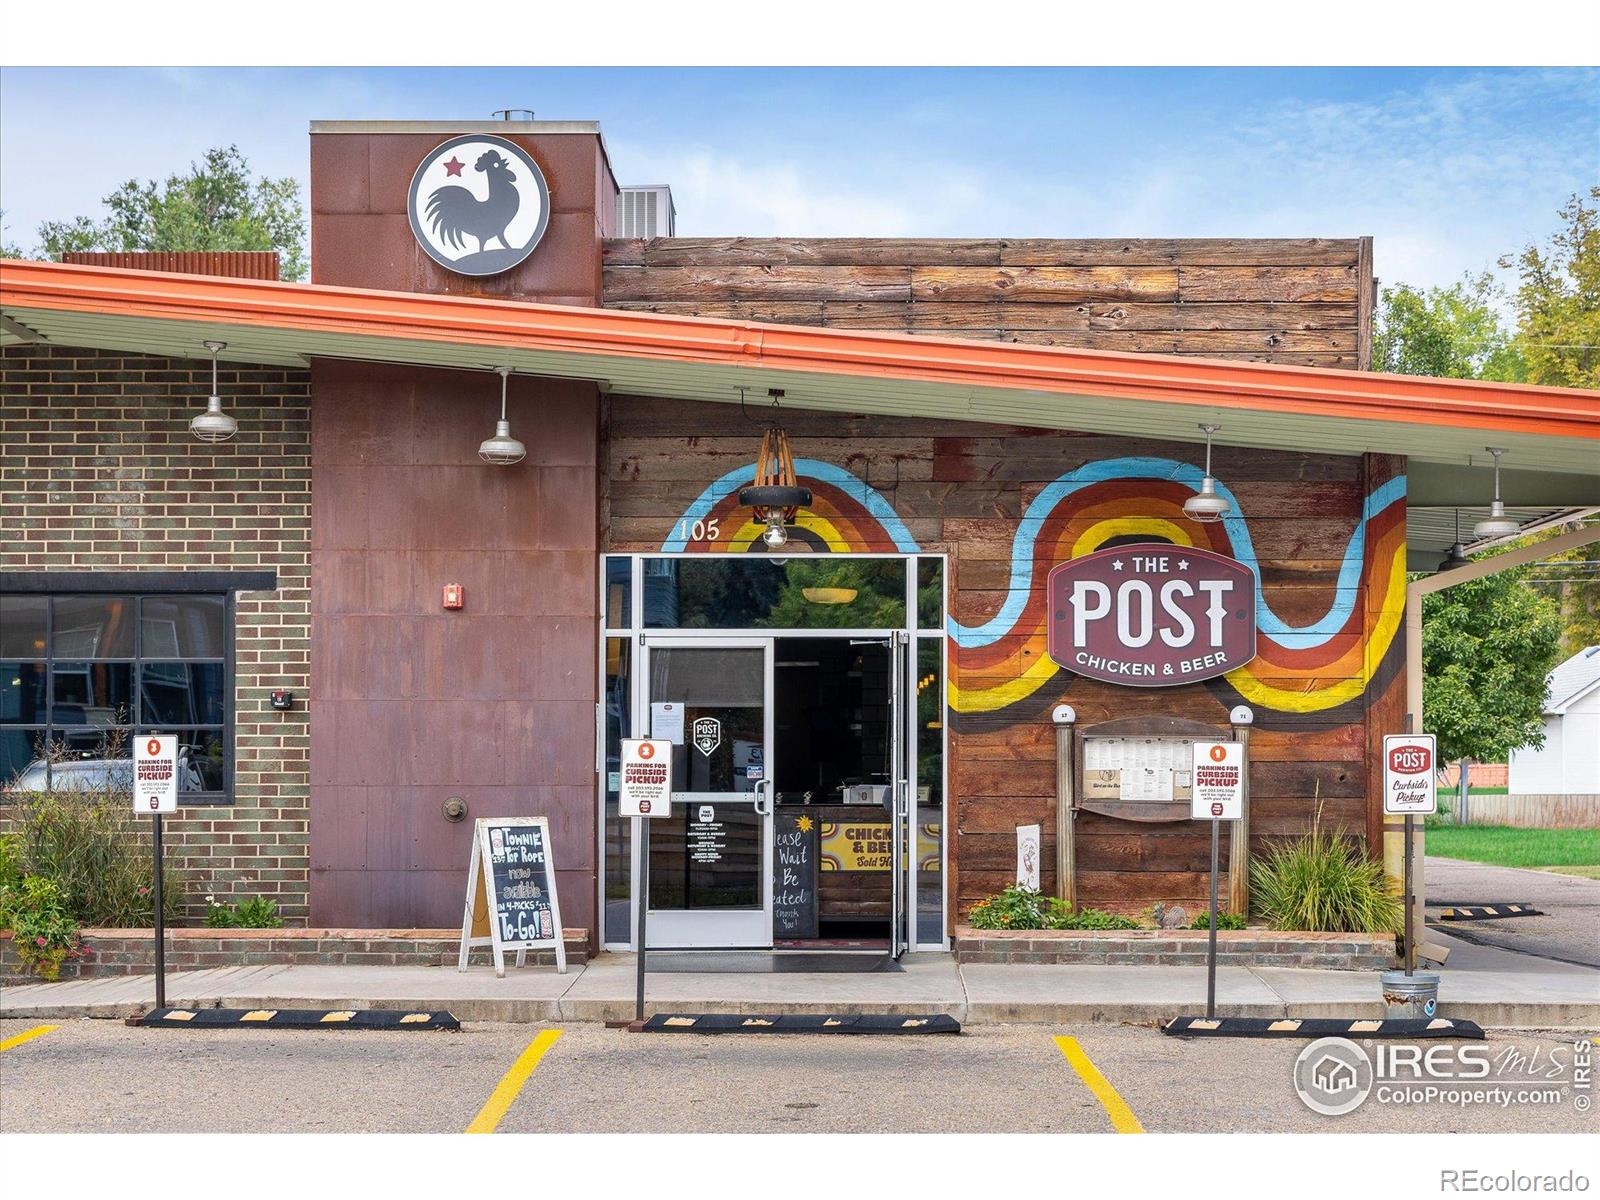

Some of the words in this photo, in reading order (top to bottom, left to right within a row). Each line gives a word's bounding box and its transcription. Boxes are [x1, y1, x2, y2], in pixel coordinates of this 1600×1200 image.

[680, 518, 720, 541] 105
[1132, 556, 1169, 573] THE
[1068, 579, 1234, 648] POST
[1076, 652, 1155, 676] CHICKEN
[1163, 662, 1174, 676] &
[1180, 651, 1228, 674] BEER
[696, 724, 718, 734] POST
[151, 743, 157, 752] 3
[642, 746, 649, 755] 2
[1215, 750, 1220, 758] 1
[1393, 752, 1426, 768] POST
[138, 772, 172, 780] PICKUP
[626, 776, 666, 784] PICKUP
[1197, 779, 1238, 787] PICKUP
[1396, 792, 1426, 804] Pickup
[774, 832, 801, 847] lease
[852, 842, 864, 853] &
[521, 846, 544, 863] ROPE
[779, 846, 807, 865] Wait
[856, 856, 878, 867] Sold
[508, 868, 530, 880] now
[784, 867, 798, 886] Be
[773, 889, 806, 905] eated
[506, 901, 534, 910] 4-PACKS
